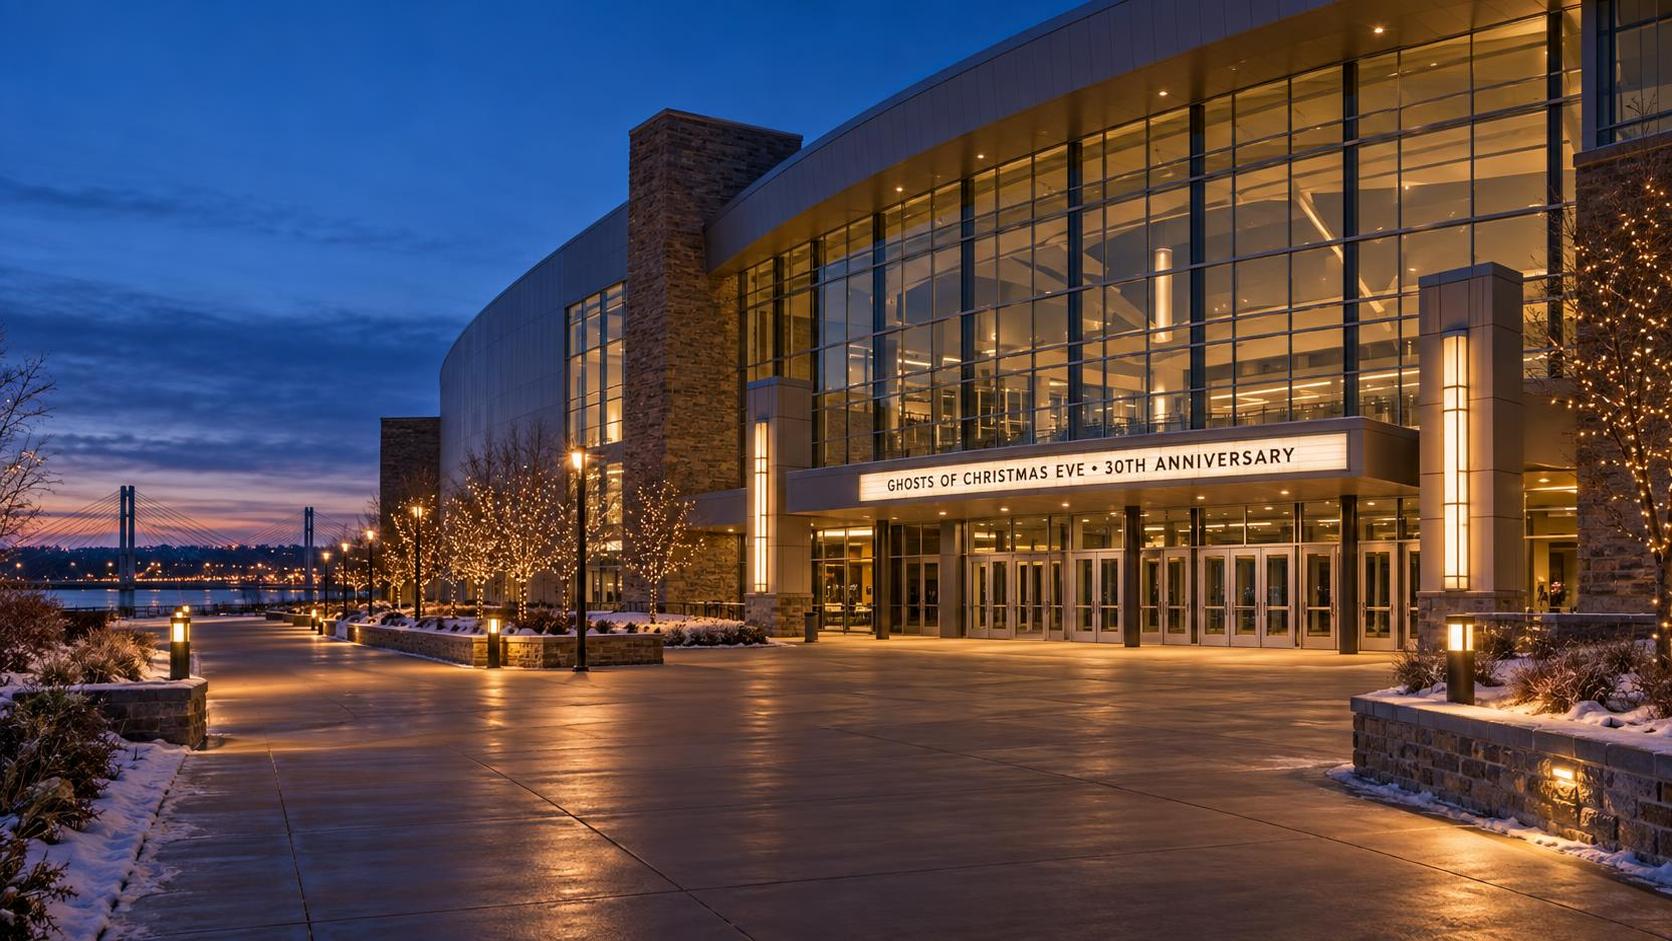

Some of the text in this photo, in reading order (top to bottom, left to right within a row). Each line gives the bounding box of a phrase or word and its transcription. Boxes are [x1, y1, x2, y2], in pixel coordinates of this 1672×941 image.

[887, 447, 1295, 492] GHOSTS OF CHRISTMAS EVE 30TH ANNIVERSARY
